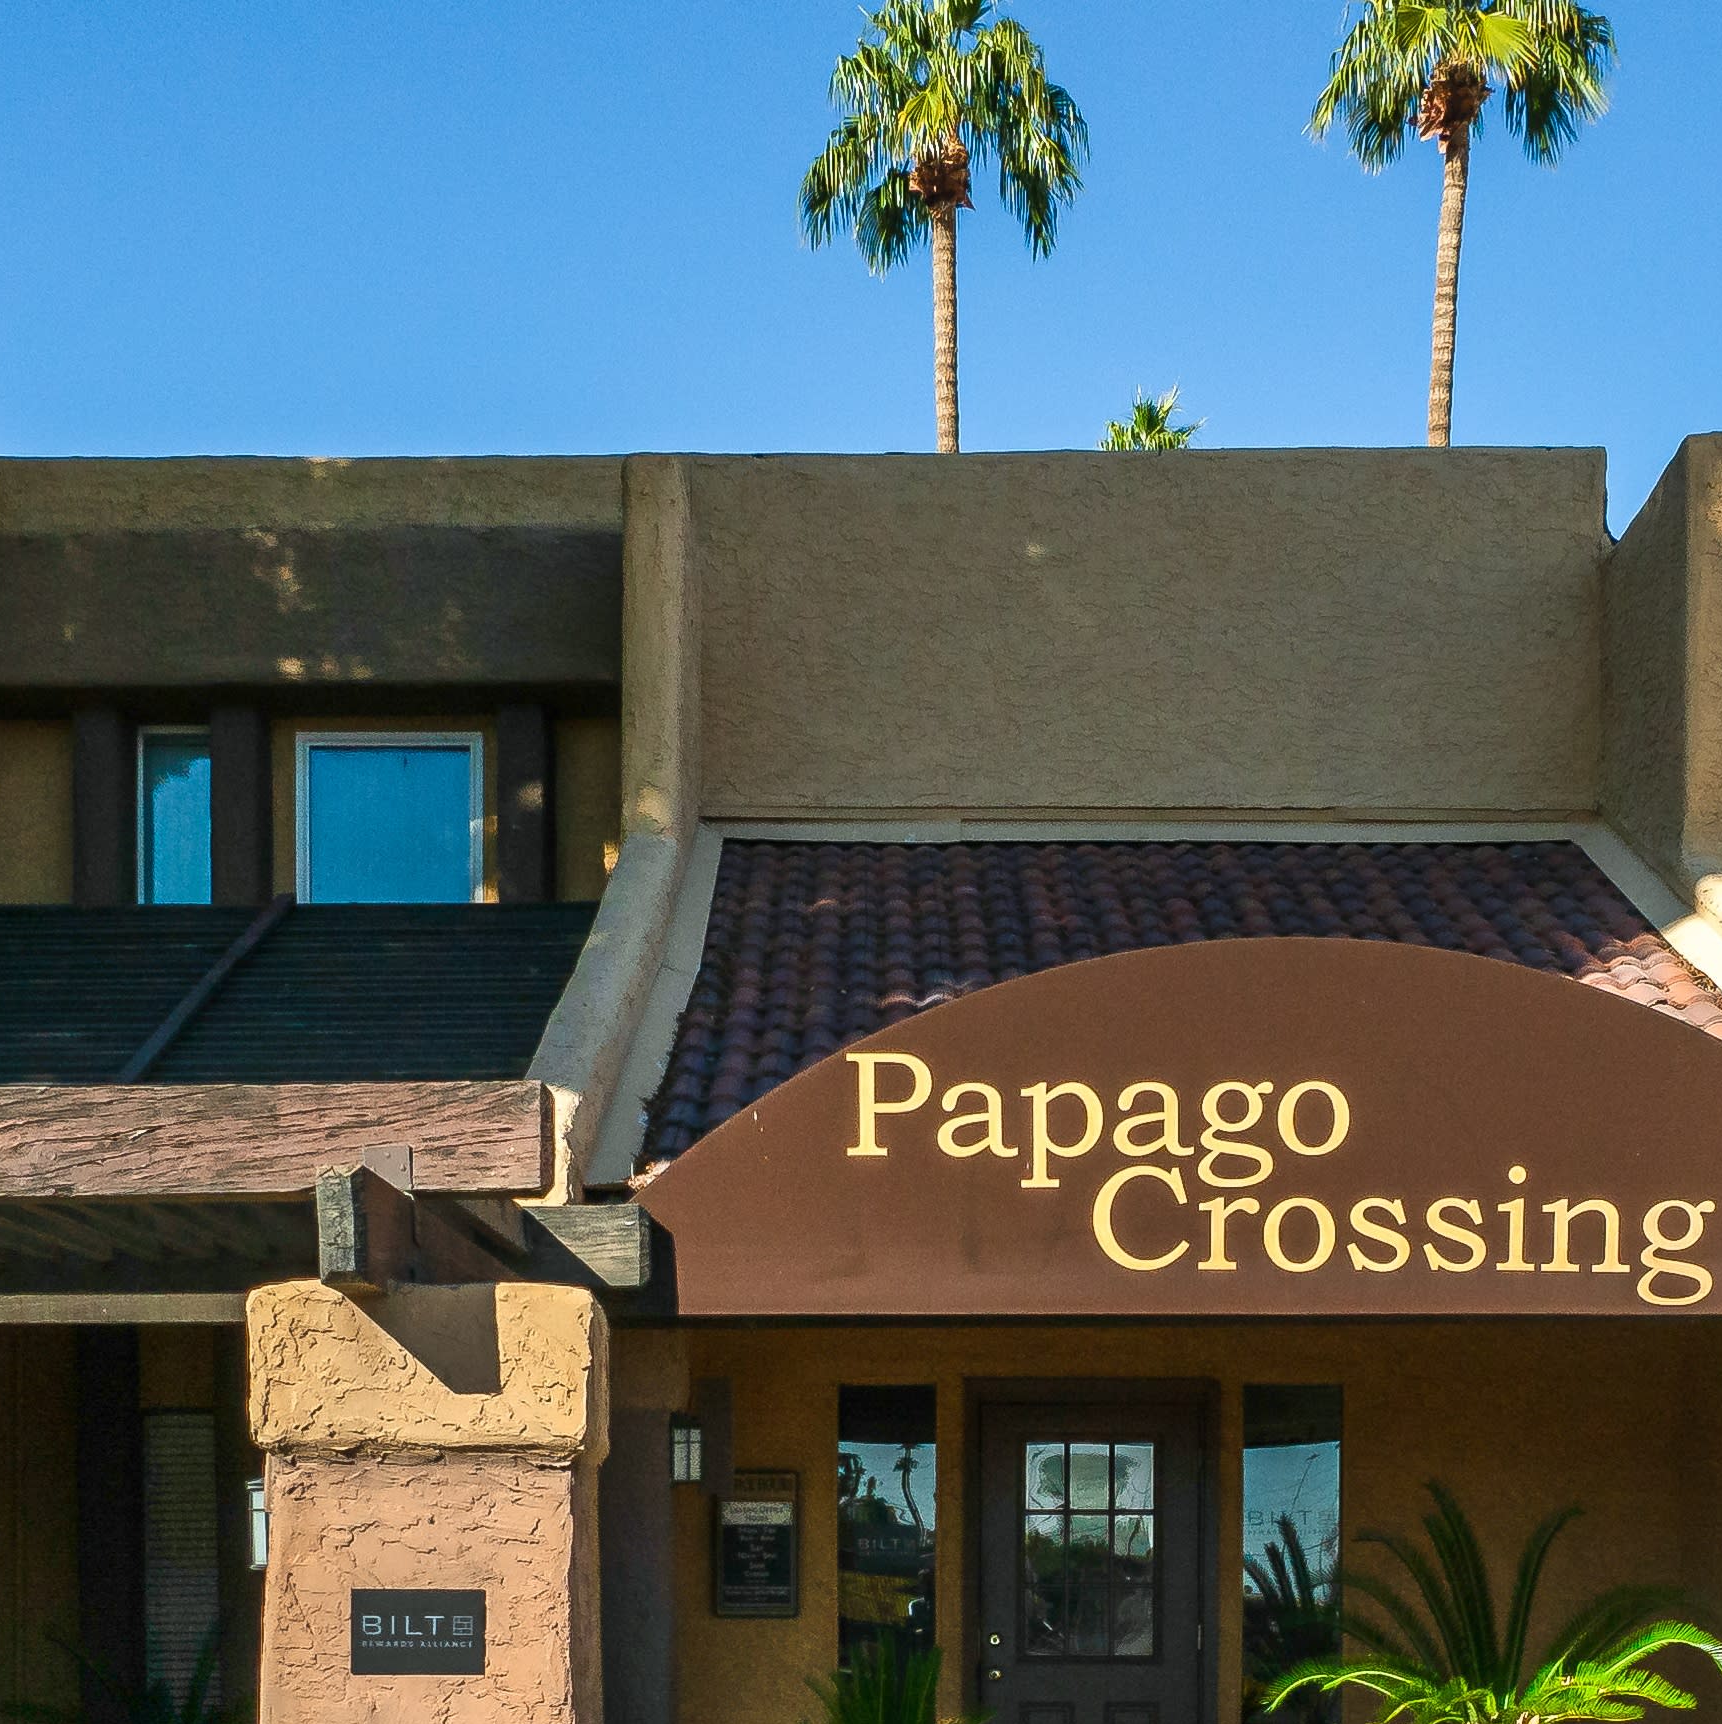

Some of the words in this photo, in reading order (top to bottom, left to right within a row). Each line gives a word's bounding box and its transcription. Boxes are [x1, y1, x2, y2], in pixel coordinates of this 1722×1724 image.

[845, 1052, 1351, 1190] Papago
[1091, 1165, 1717, 1307] Crossing
[1247, 1510, 1312, 1526] BIT
[361, 1615, 446, 1636] BILT
[420, 1640, 474, 1648] ALLIANCE
